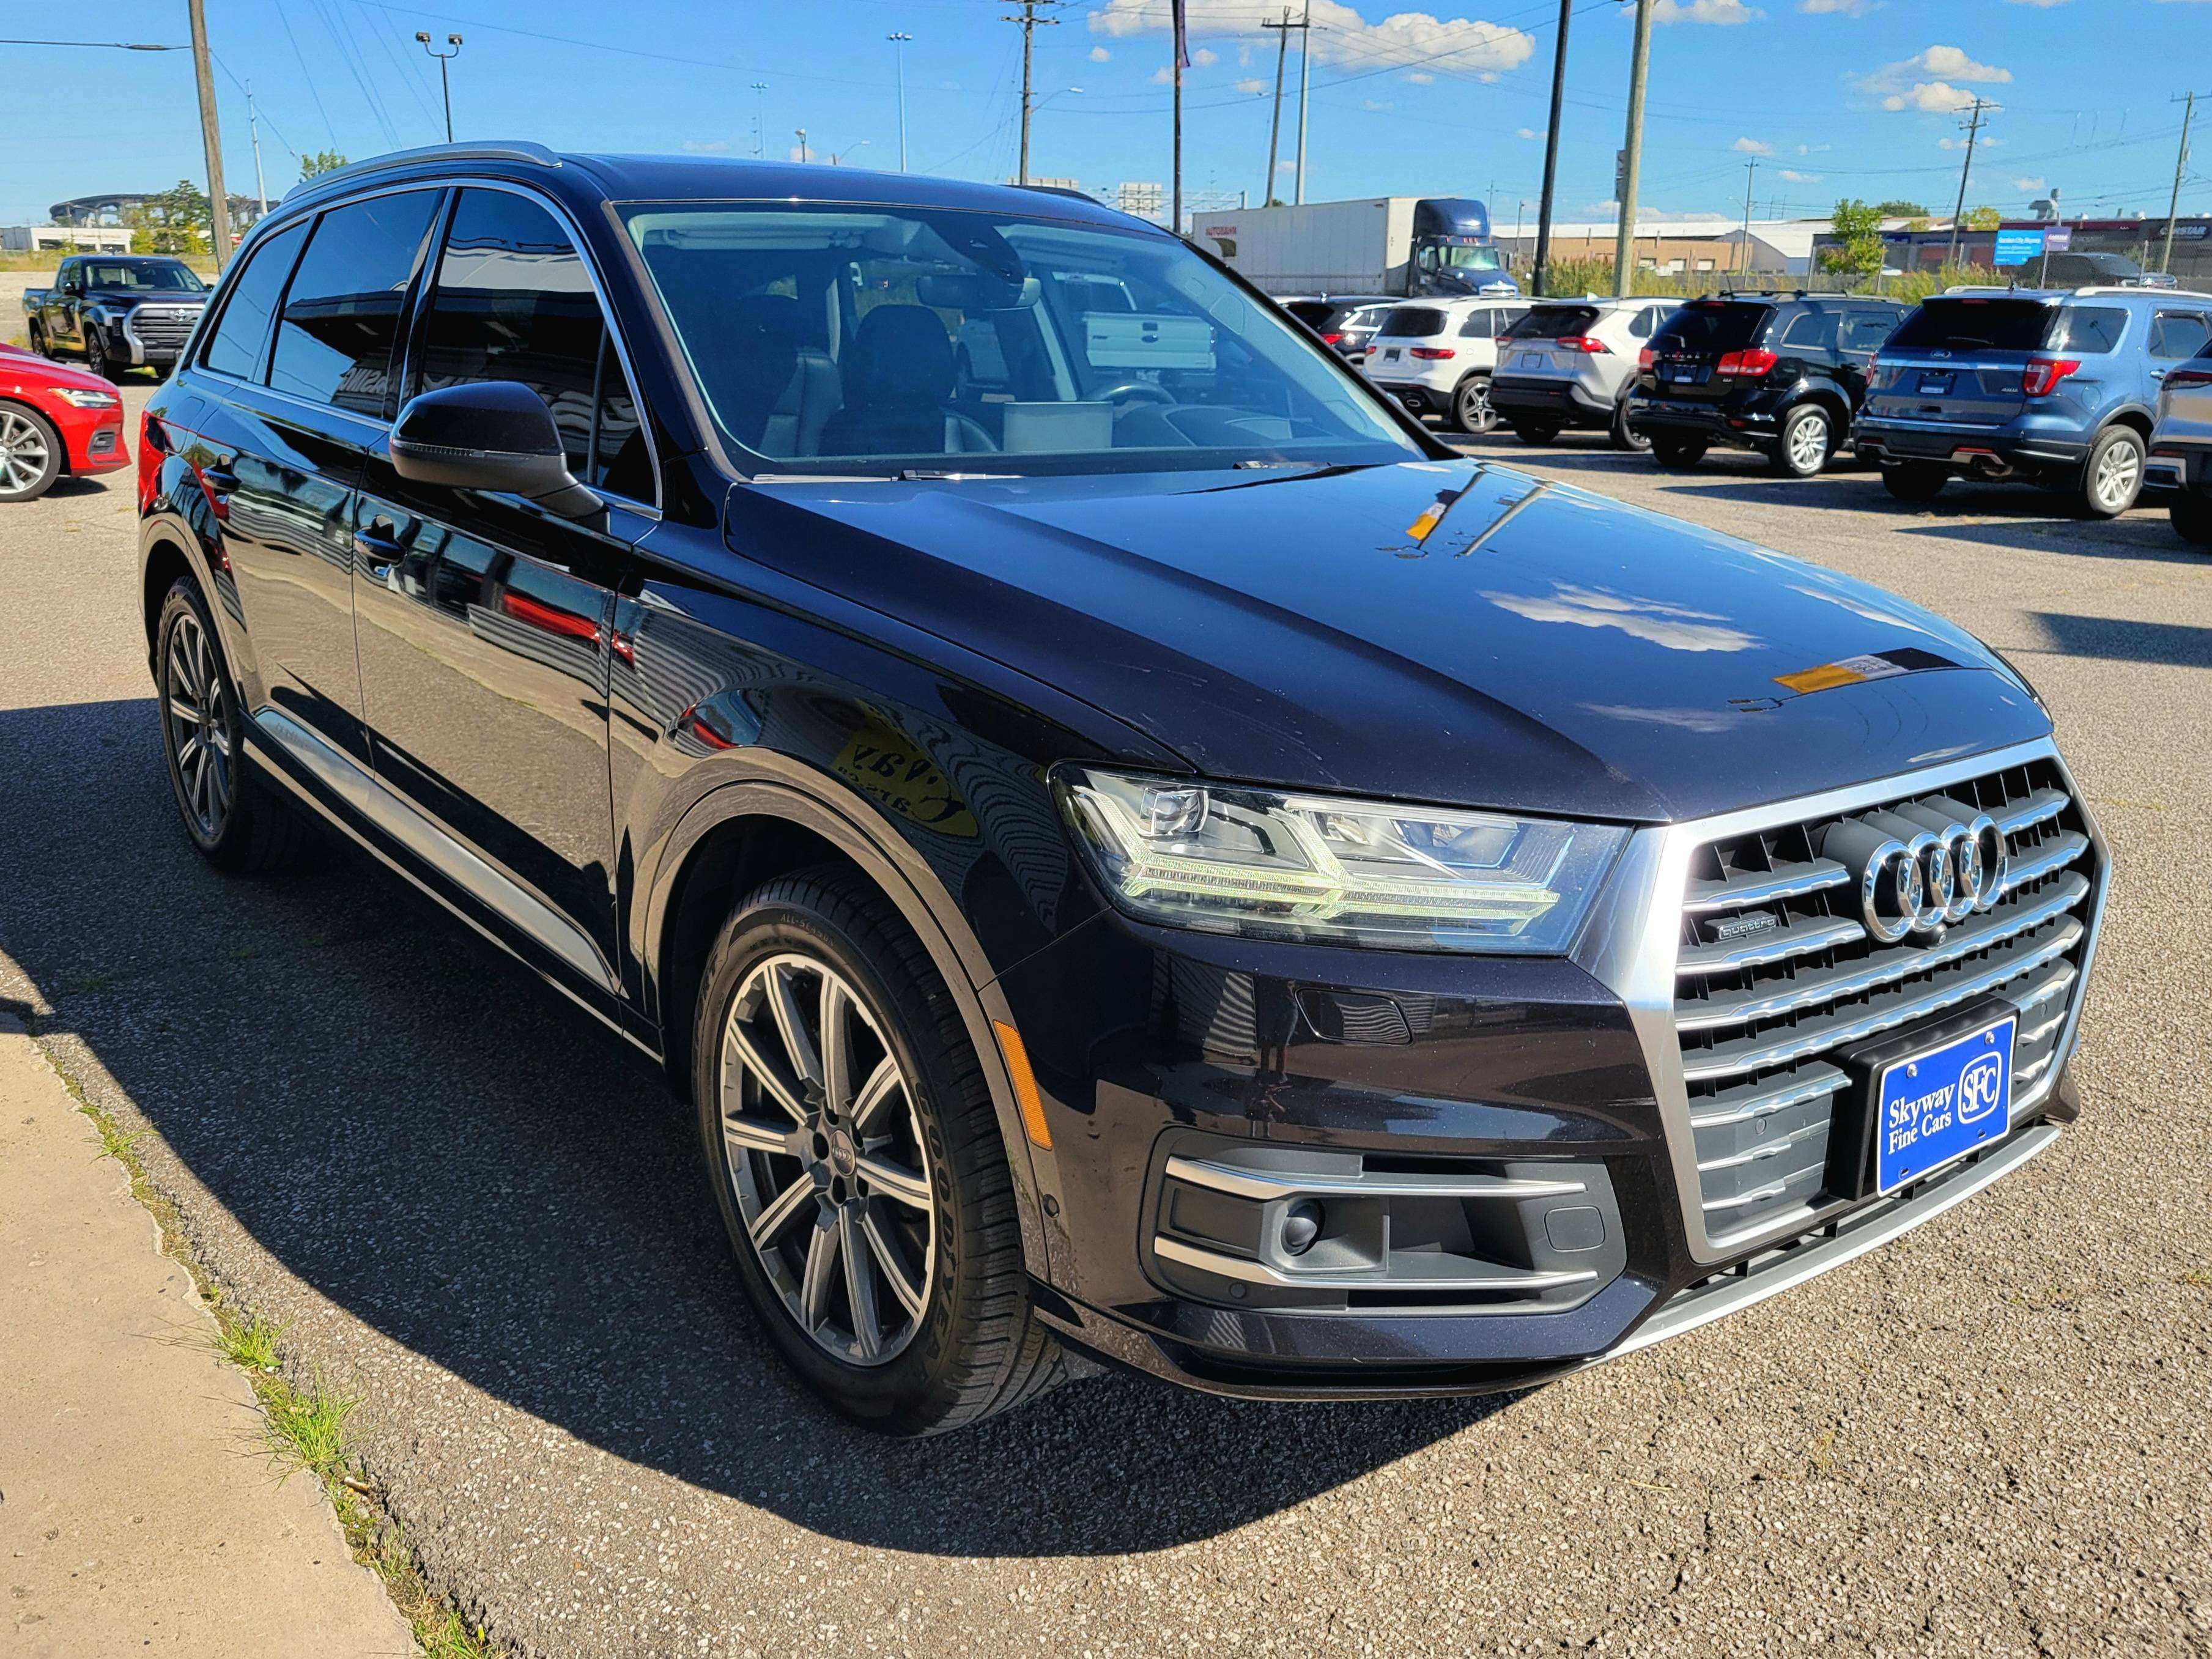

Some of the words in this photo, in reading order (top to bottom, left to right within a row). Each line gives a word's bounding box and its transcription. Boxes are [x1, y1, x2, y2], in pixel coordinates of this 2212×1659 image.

[2159, 226, 2206, 235] CRSTAR
[780, 914, 837, 947] ALL-SEASON
[1722, 918, 1775, 937] quattro
[1888, 1083, 1955, 1128] Skyway
[1962, 1065, 1996, 1113] SFC
[1888, 1127, 1918, 1155] Fine
[1922, 1111, 1951, 1137] Cars
[915, 1081, 958, 1380] GOODYEA
